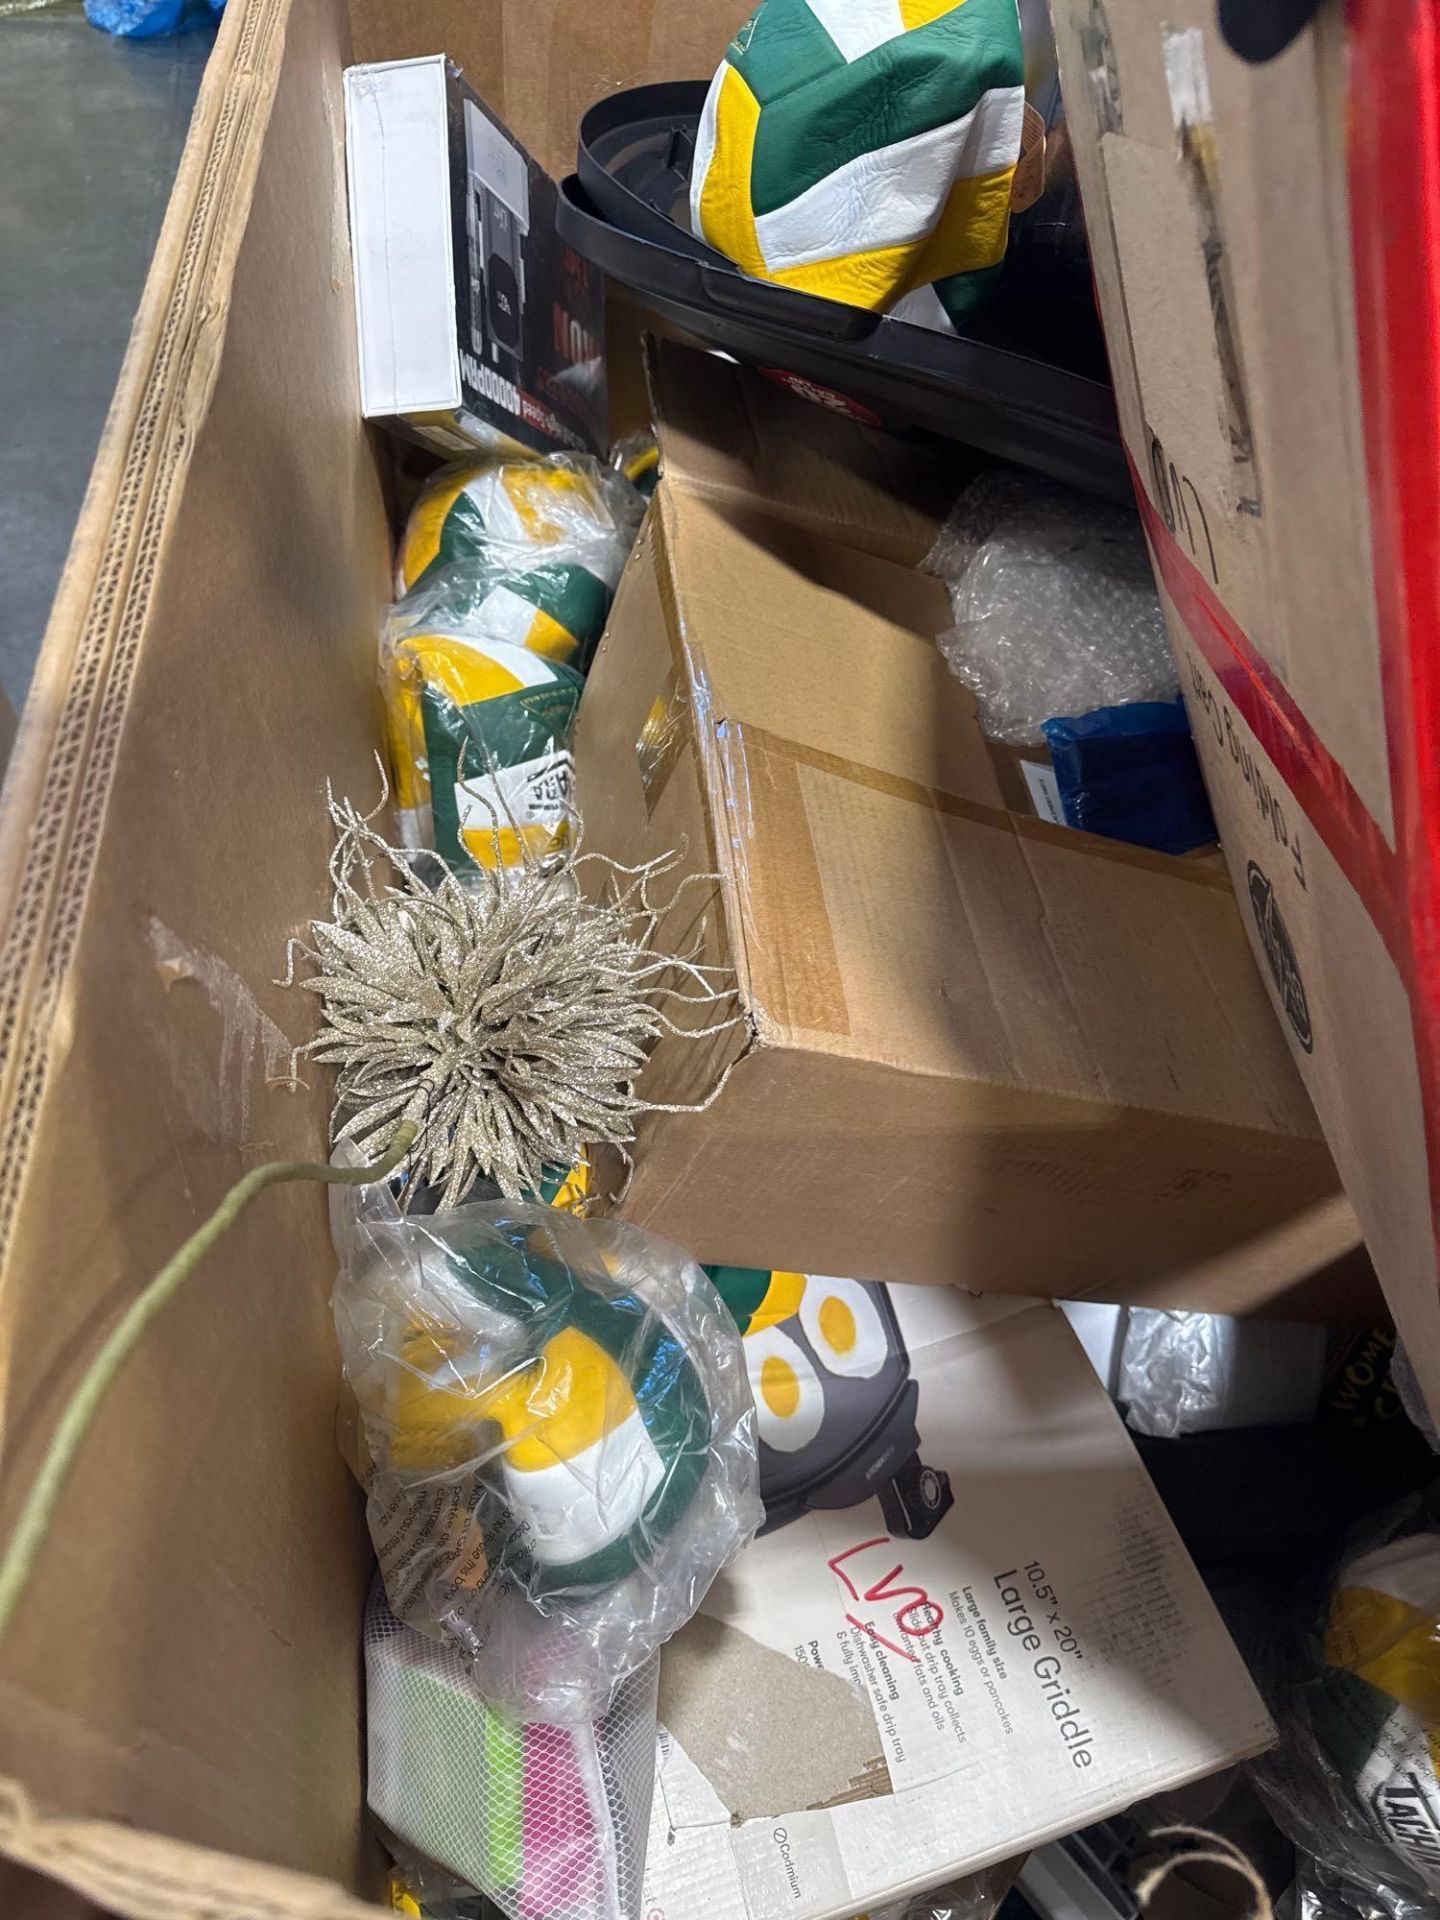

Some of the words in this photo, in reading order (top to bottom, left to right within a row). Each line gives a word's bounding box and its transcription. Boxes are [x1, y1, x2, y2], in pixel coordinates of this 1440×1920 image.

[1222, 704, 1309, 893] Folding
[949, 1590, 968, 1626] Makes
[1024, 1559, 1058, 1605] 10.5"
[962, 1585, 980, 1618] Large
[976, 1618, 997, 1656] family
[993, 1655, 1007, 1680] size
[963, 1625, 976, 1638] 10
[1047, 1611, 1061, 1624] x
[1053, 1626, 1084, 1660] 20"
[840, 1641, 855, 1665] fully
[865, 1621, 881, 1650] Easy
[876, 1649, 900, 1700] cleaning
[940, 1649, 965, 1697] cooking
[969, 1639, 985, 1666] eggs
[980, 1667, 992, 1679] or
[993, 1569, 1042, 1651] Large
[1034, 1656, 1093, 1769] Griddle
[850, 1626, 878, 1686] Dishwasher
[873, 1687, 888, 1712] safe
[883, 1712, 898, 1738] drip
[892, 1738, 906, 1763] tray
[913, 1663, 928, 1687] fats
[922, 1686, 938, 1710] and
[932, 1710, 945, 1731] oils
[925, 1651, 939, 1675] drip
[934, 1675, 949, 1701] tray
[944, 1700, 967, 1744] collects
[984, 1679, 1014, 1735] pancakes
[780, 1843, 802, 1899] Cadmium
